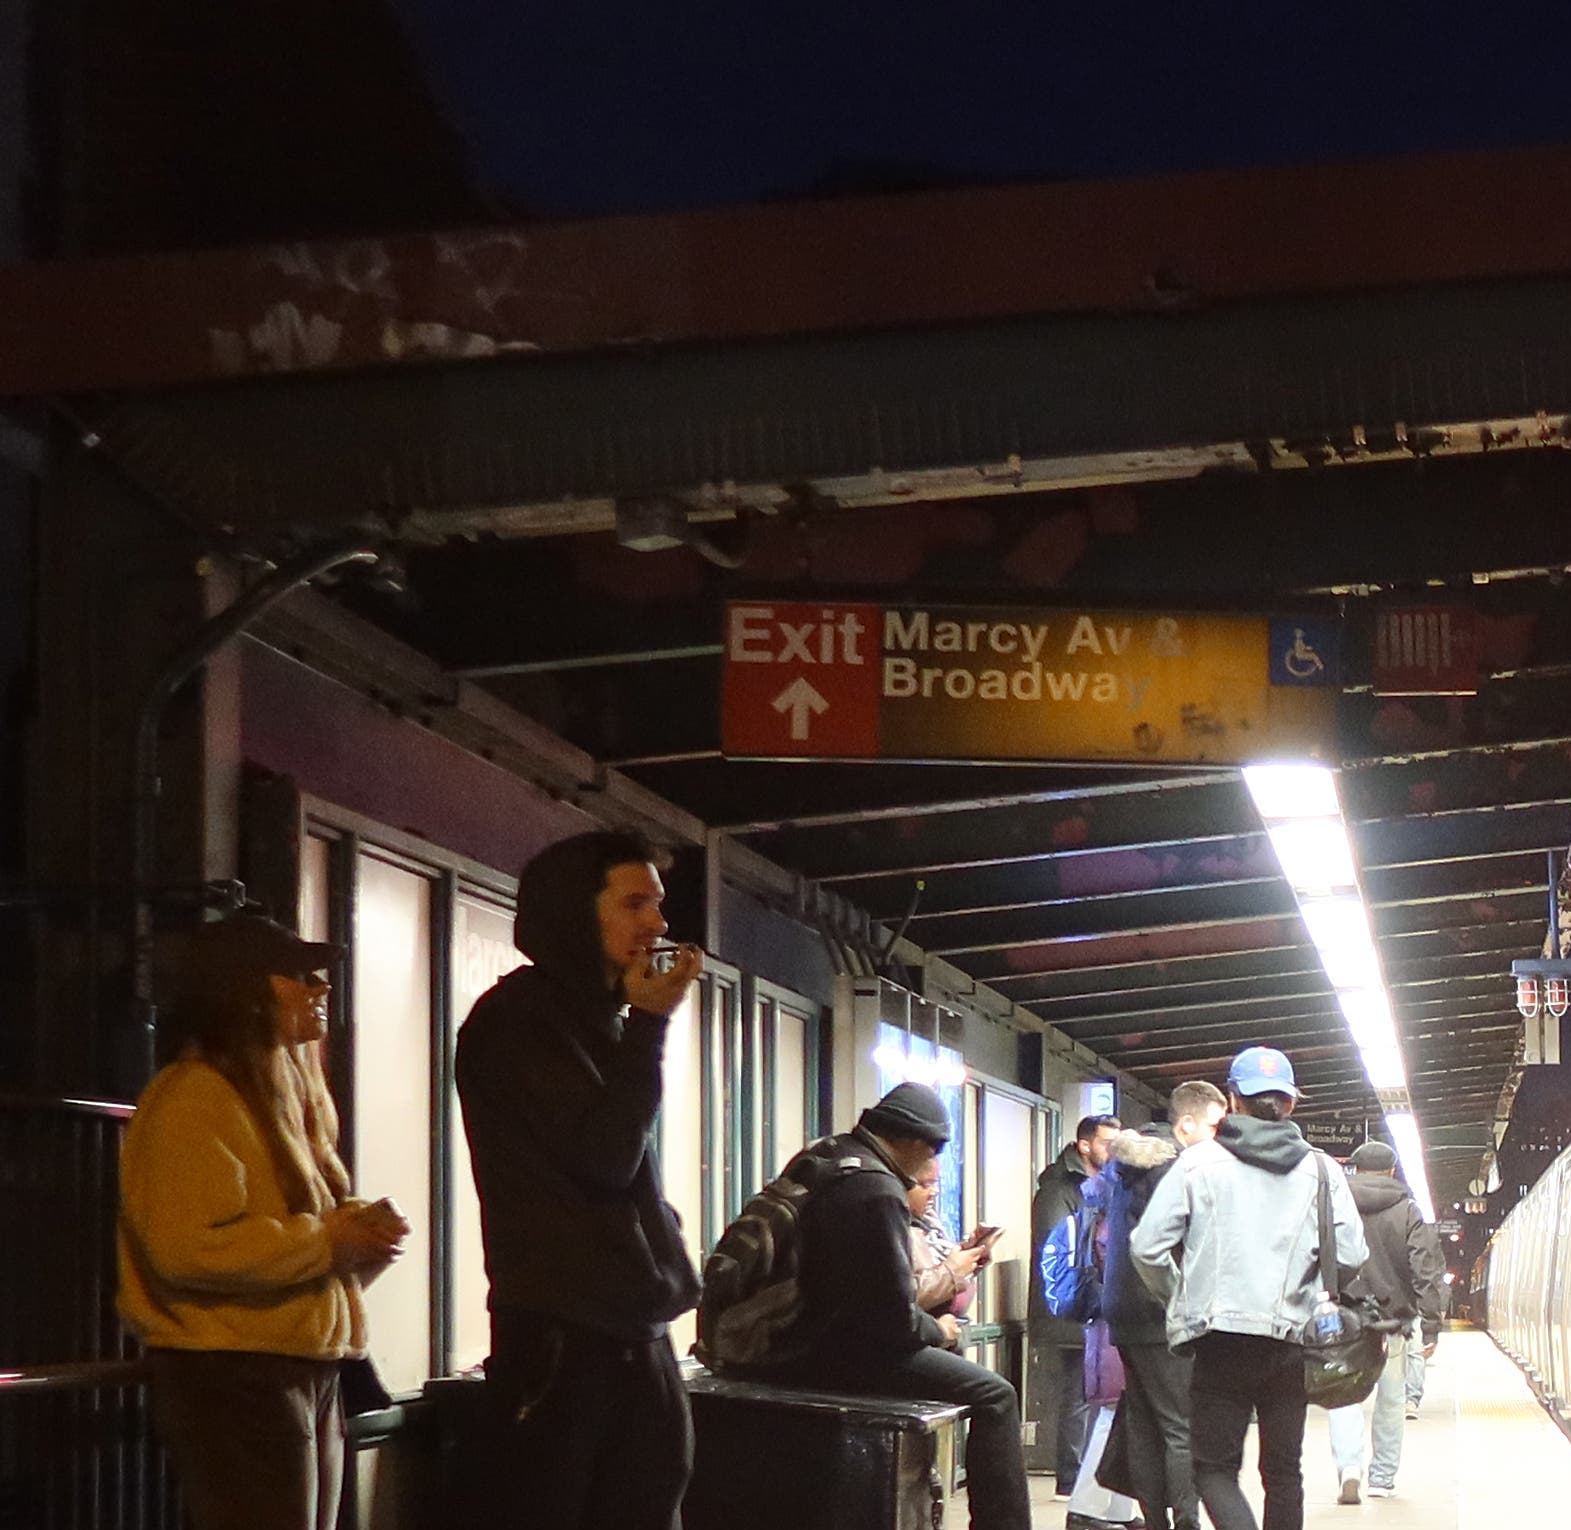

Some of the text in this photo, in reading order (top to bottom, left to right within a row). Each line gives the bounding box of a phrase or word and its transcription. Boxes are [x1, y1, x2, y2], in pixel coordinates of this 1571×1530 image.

[728, 607, 865, 666] Exit
[883, 611, 1184, 663] Marcy Av &
[882, 657, 1151, 712] Broadway
[1307, 1124, 1336, 1134] Marcy
[1307, 1135, 1354, 1144] Broadway
